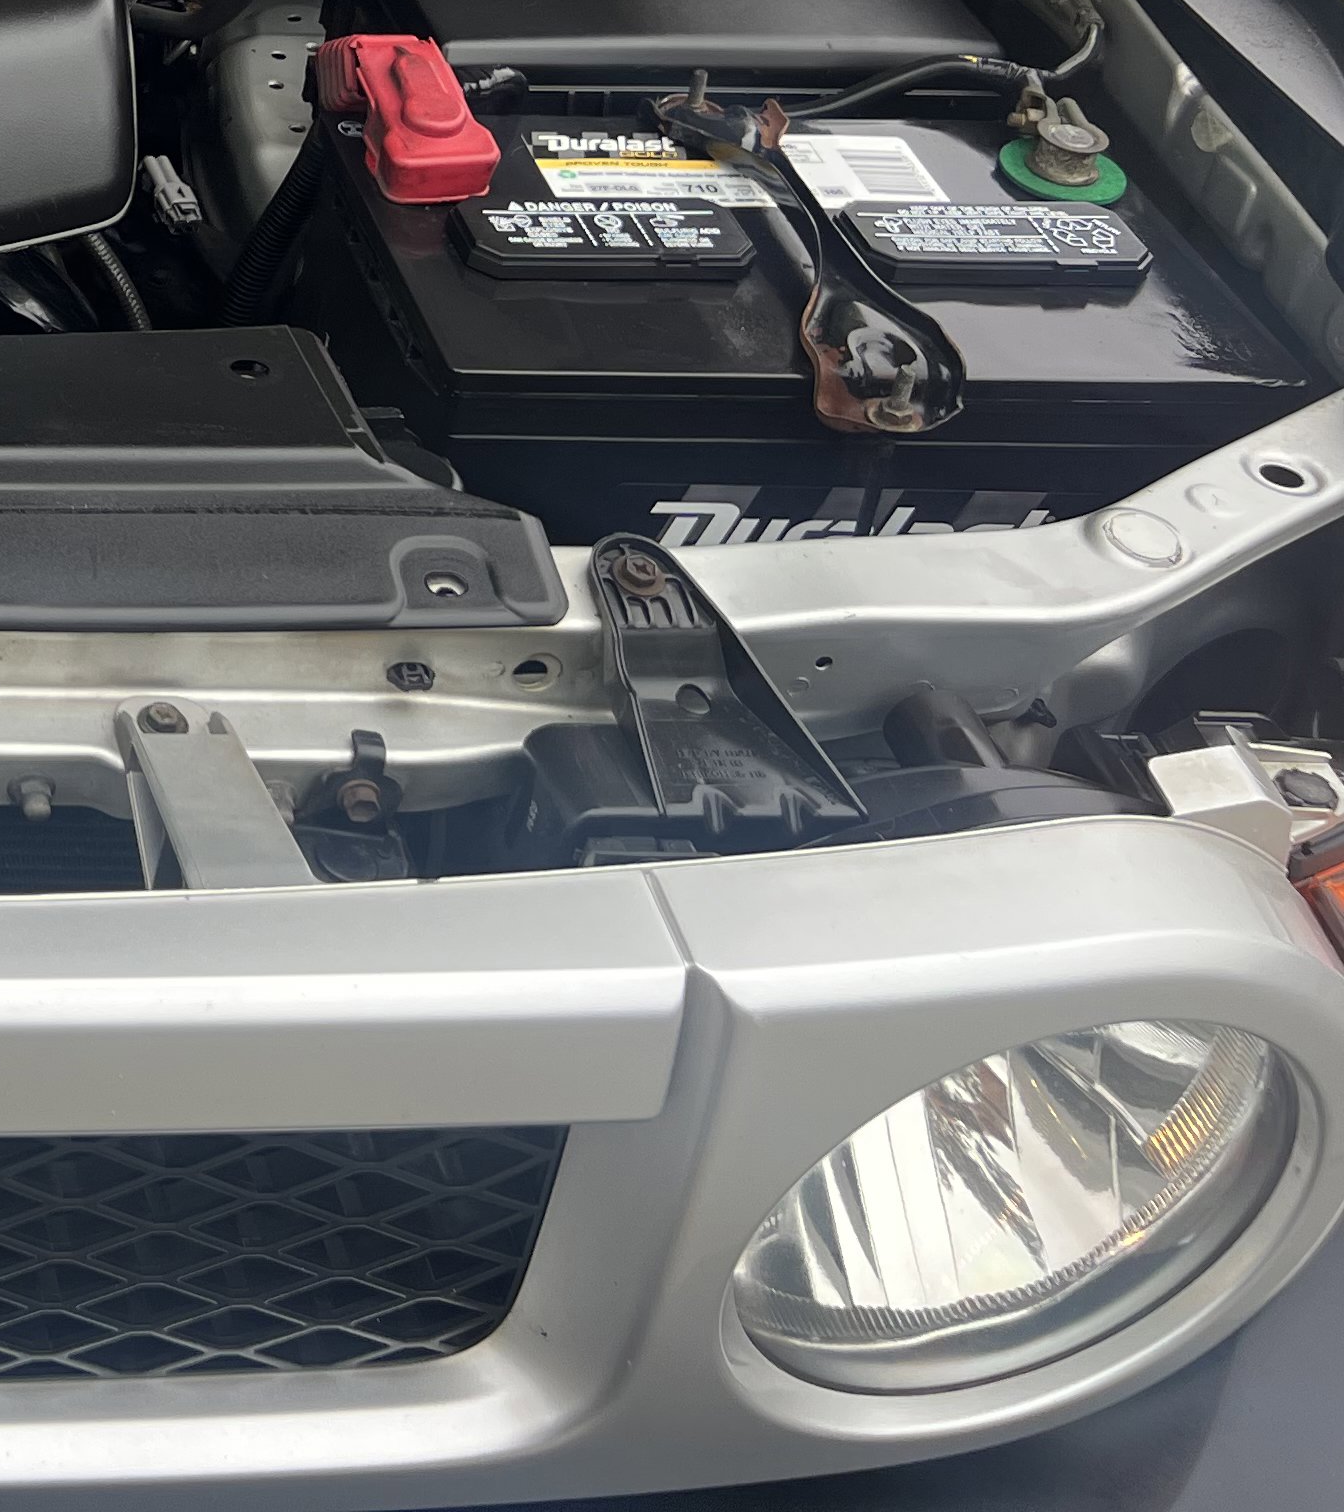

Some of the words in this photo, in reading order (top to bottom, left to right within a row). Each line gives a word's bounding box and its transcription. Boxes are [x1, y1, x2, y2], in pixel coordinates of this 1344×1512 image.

[538, 134, 676, 152] Duralast
[685, 184, 718, 194] 710
[523, 201, 596, 212] DANGER
[611, 202, 678, 212] POISON
